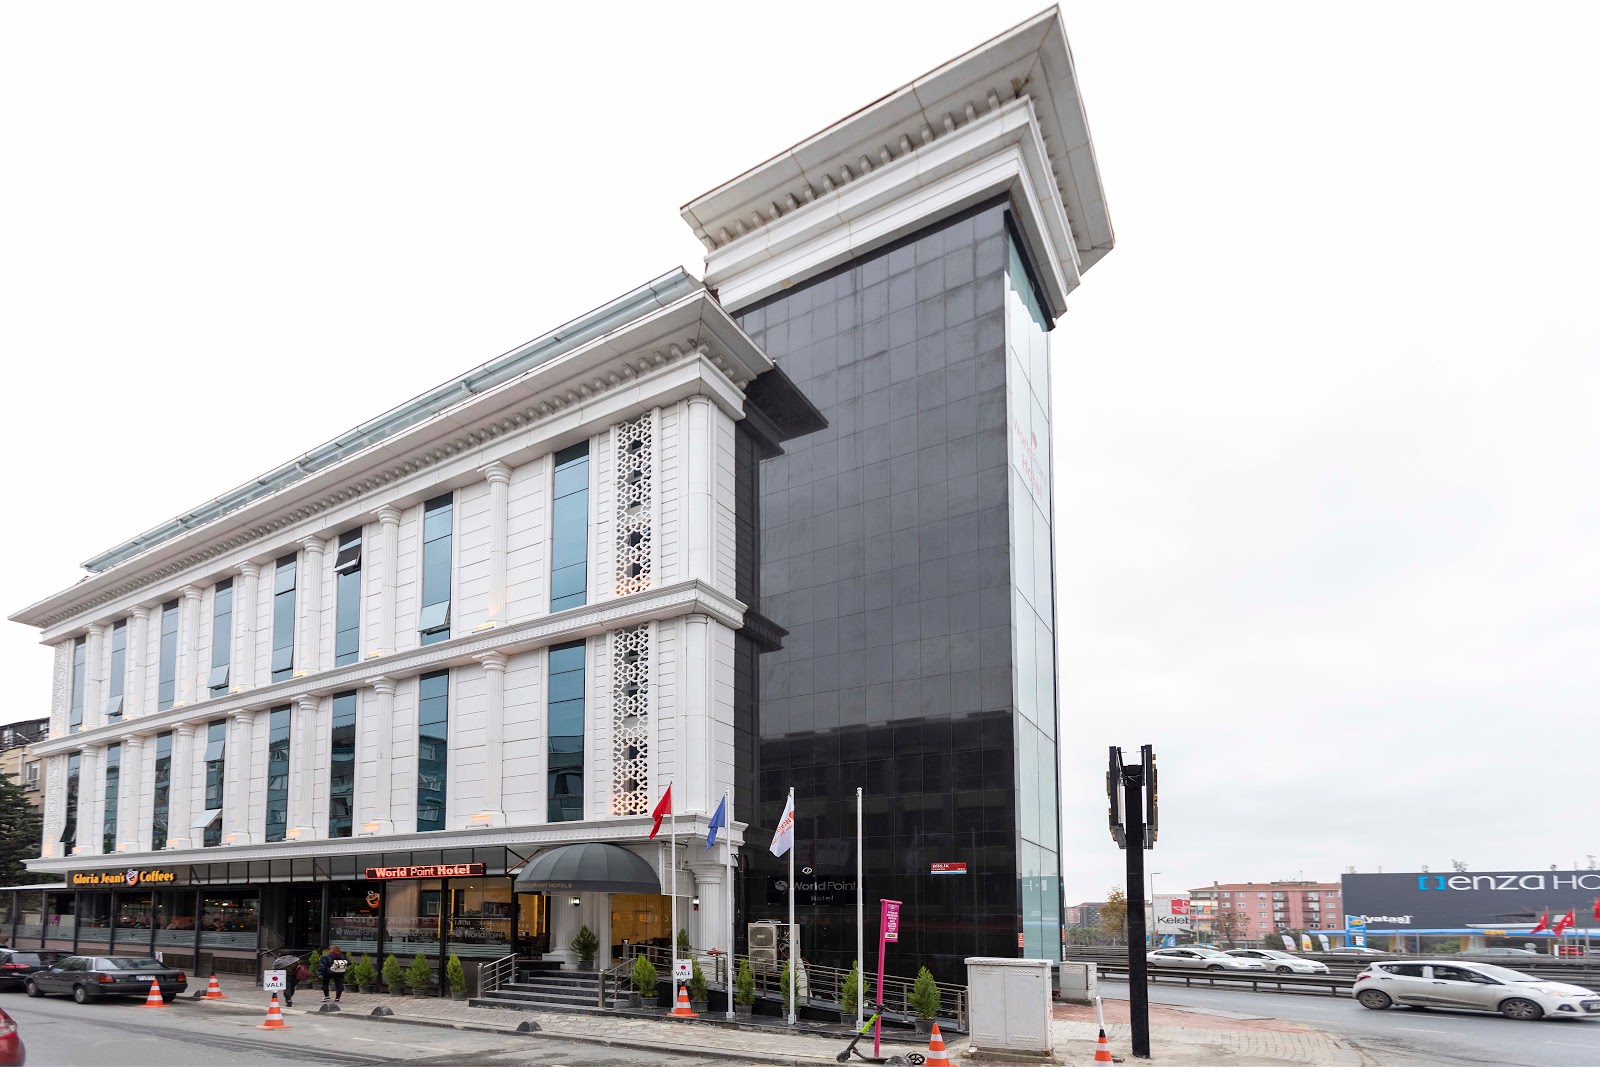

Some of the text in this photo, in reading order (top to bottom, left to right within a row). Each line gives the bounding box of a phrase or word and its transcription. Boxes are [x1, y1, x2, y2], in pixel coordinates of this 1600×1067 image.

[73, 870, 174, 884] Gloria Jean's Coffees
[375, 864, 470, 878] World Point Hotel
[1447, 874, 1546, 890] enza
